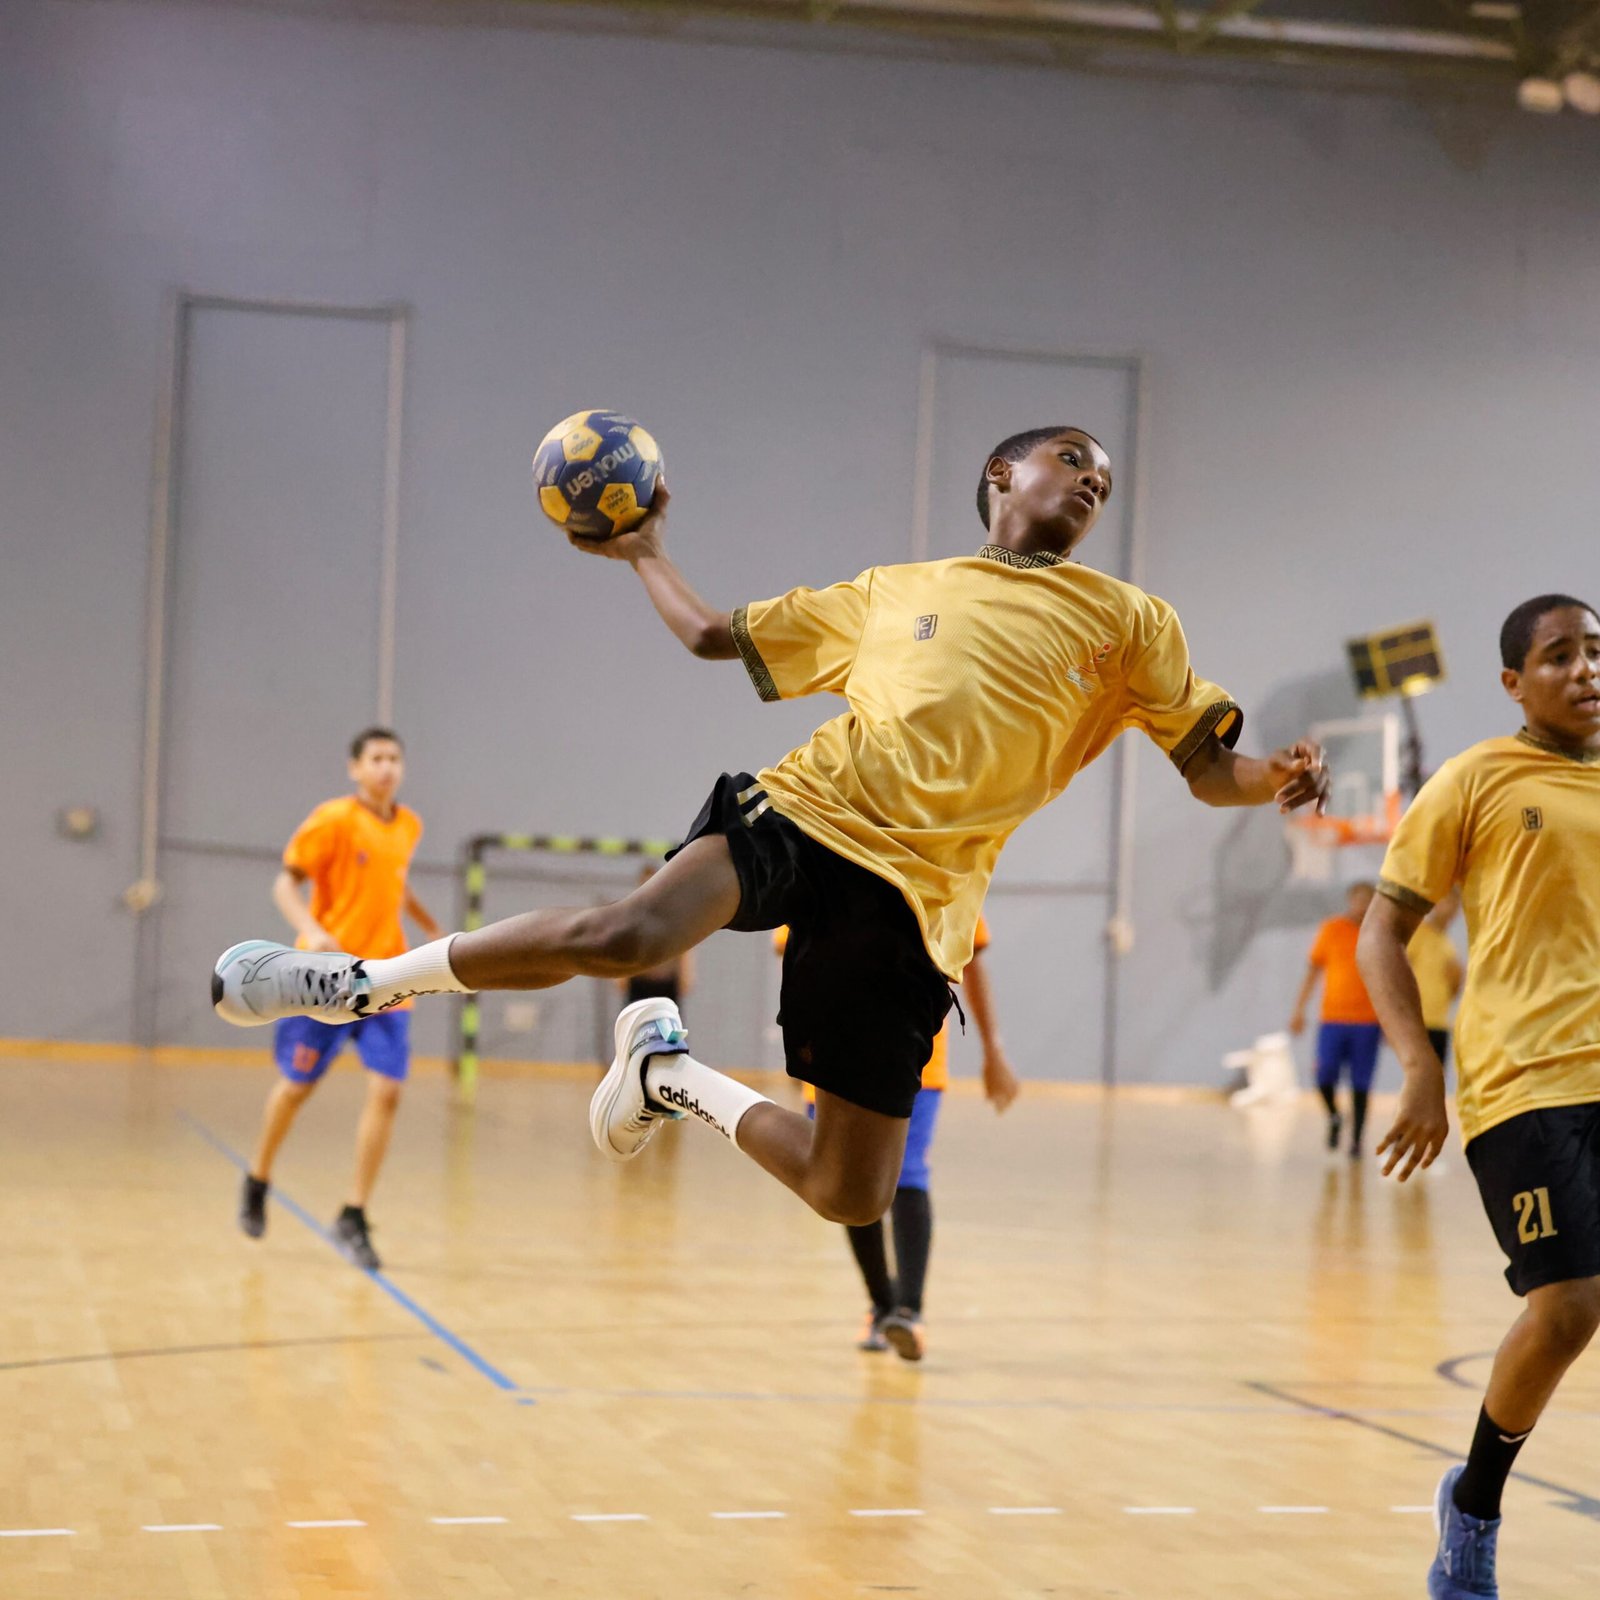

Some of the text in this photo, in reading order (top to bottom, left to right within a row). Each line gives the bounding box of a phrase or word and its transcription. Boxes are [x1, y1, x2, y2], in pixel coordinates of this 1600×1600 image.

[566, 442, 636, 497] molten
[658, 1084, 719, 1130] adidas
[1512, 1186, 1558, 1244] 21
